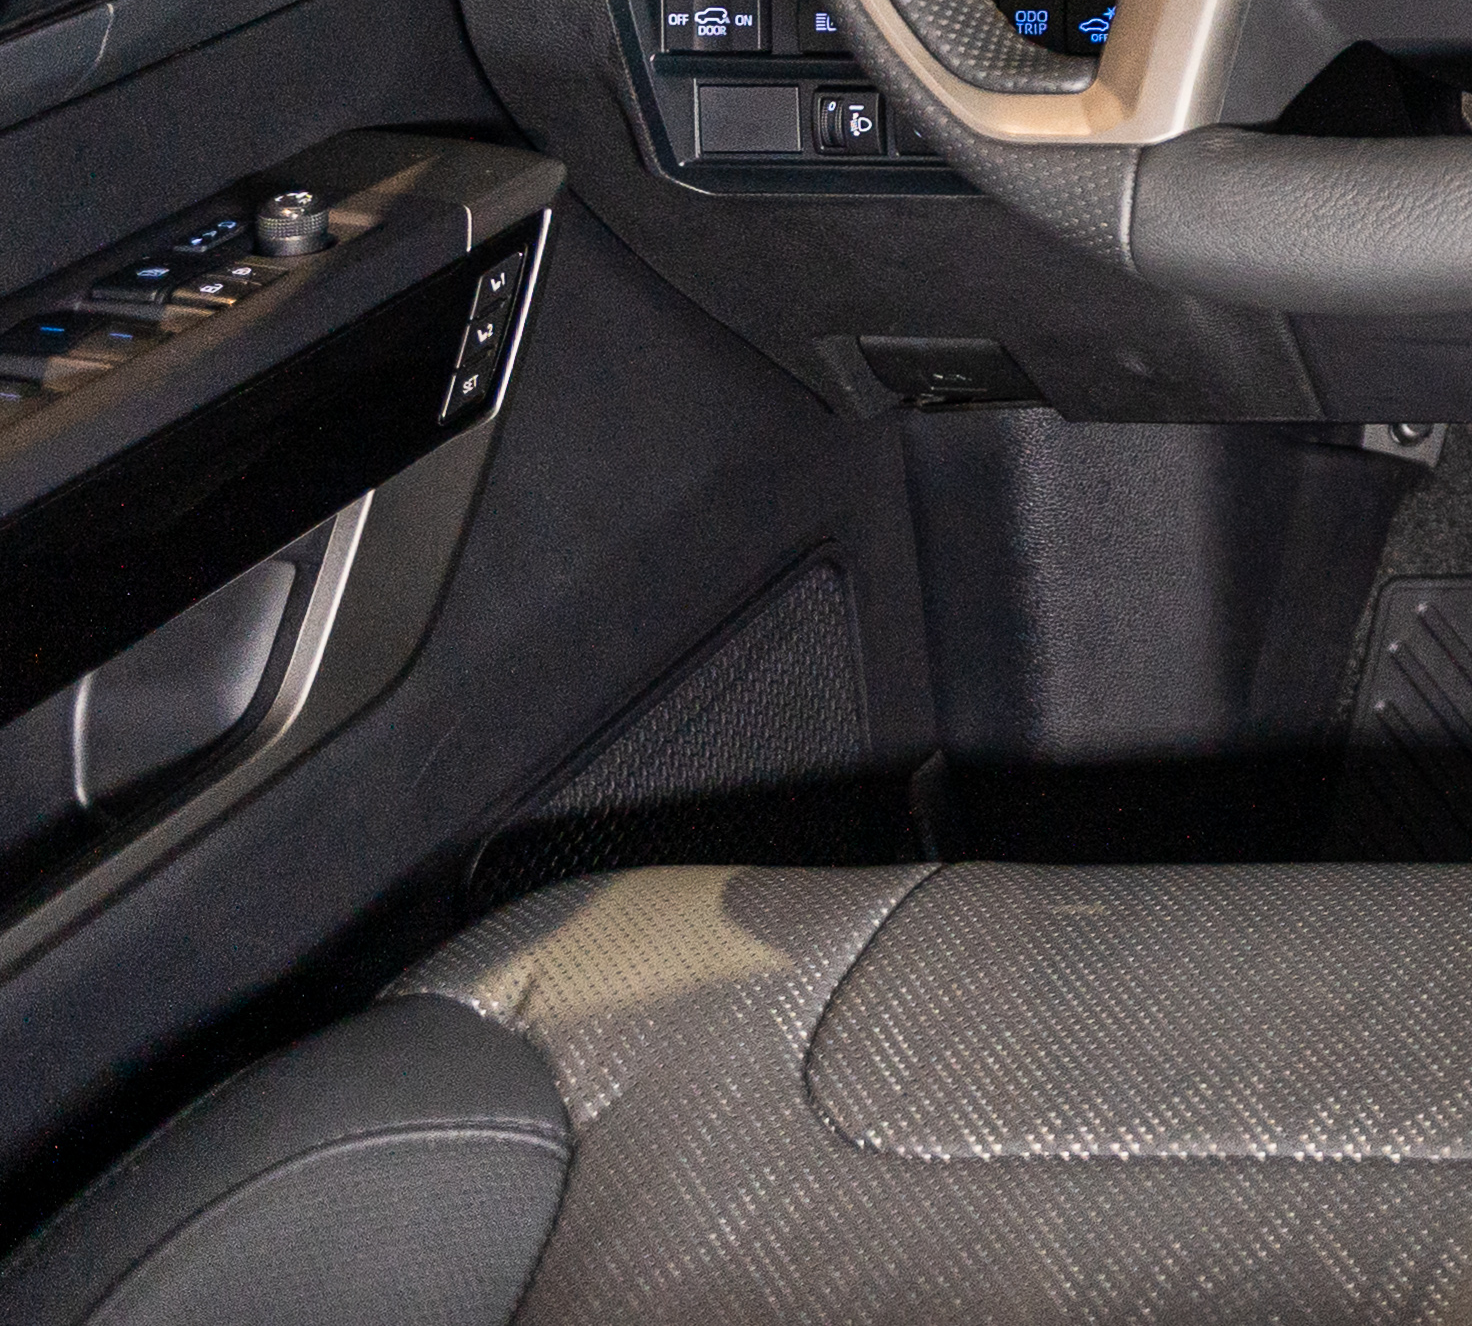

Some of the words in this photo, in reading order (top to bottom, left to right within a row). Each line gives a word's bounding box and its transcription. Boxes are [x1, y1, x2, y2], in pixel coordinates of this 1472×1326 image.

[668, 13, 689, 26] OFF
[735, 15, 752, 26] ON
[1015, 10, 1048, 23] ODO
[698, 25, 727, 36] DOOR
[1016, 23, 1047, 35] TRIP
[1091, 33, 1108, 43] OFF
[462, 374, 479, 394] SET
